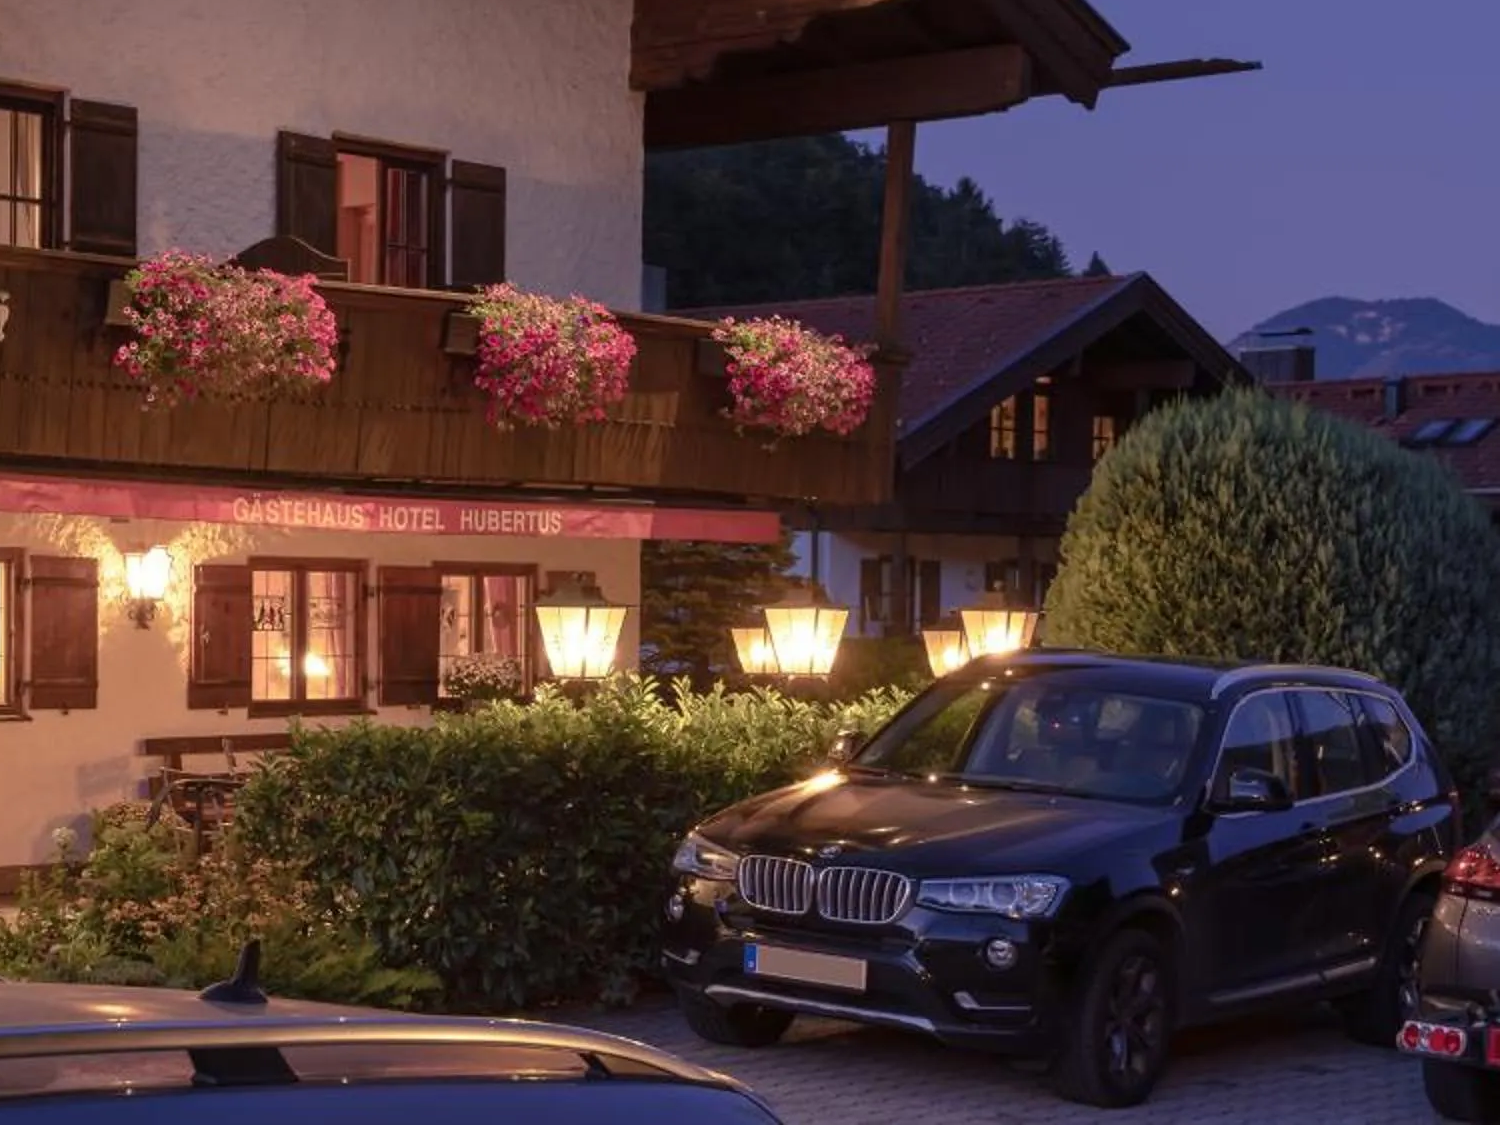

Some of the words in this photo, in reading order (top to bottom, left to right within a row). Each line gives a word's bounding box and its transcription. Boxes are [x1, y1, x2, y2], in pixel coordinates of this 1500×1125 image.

[232, 493, 365, 527] GÄSTEHAUS
[379, 507, 445, 532] HOTEL
[460, 509, 563, 535] HUBERTUS
